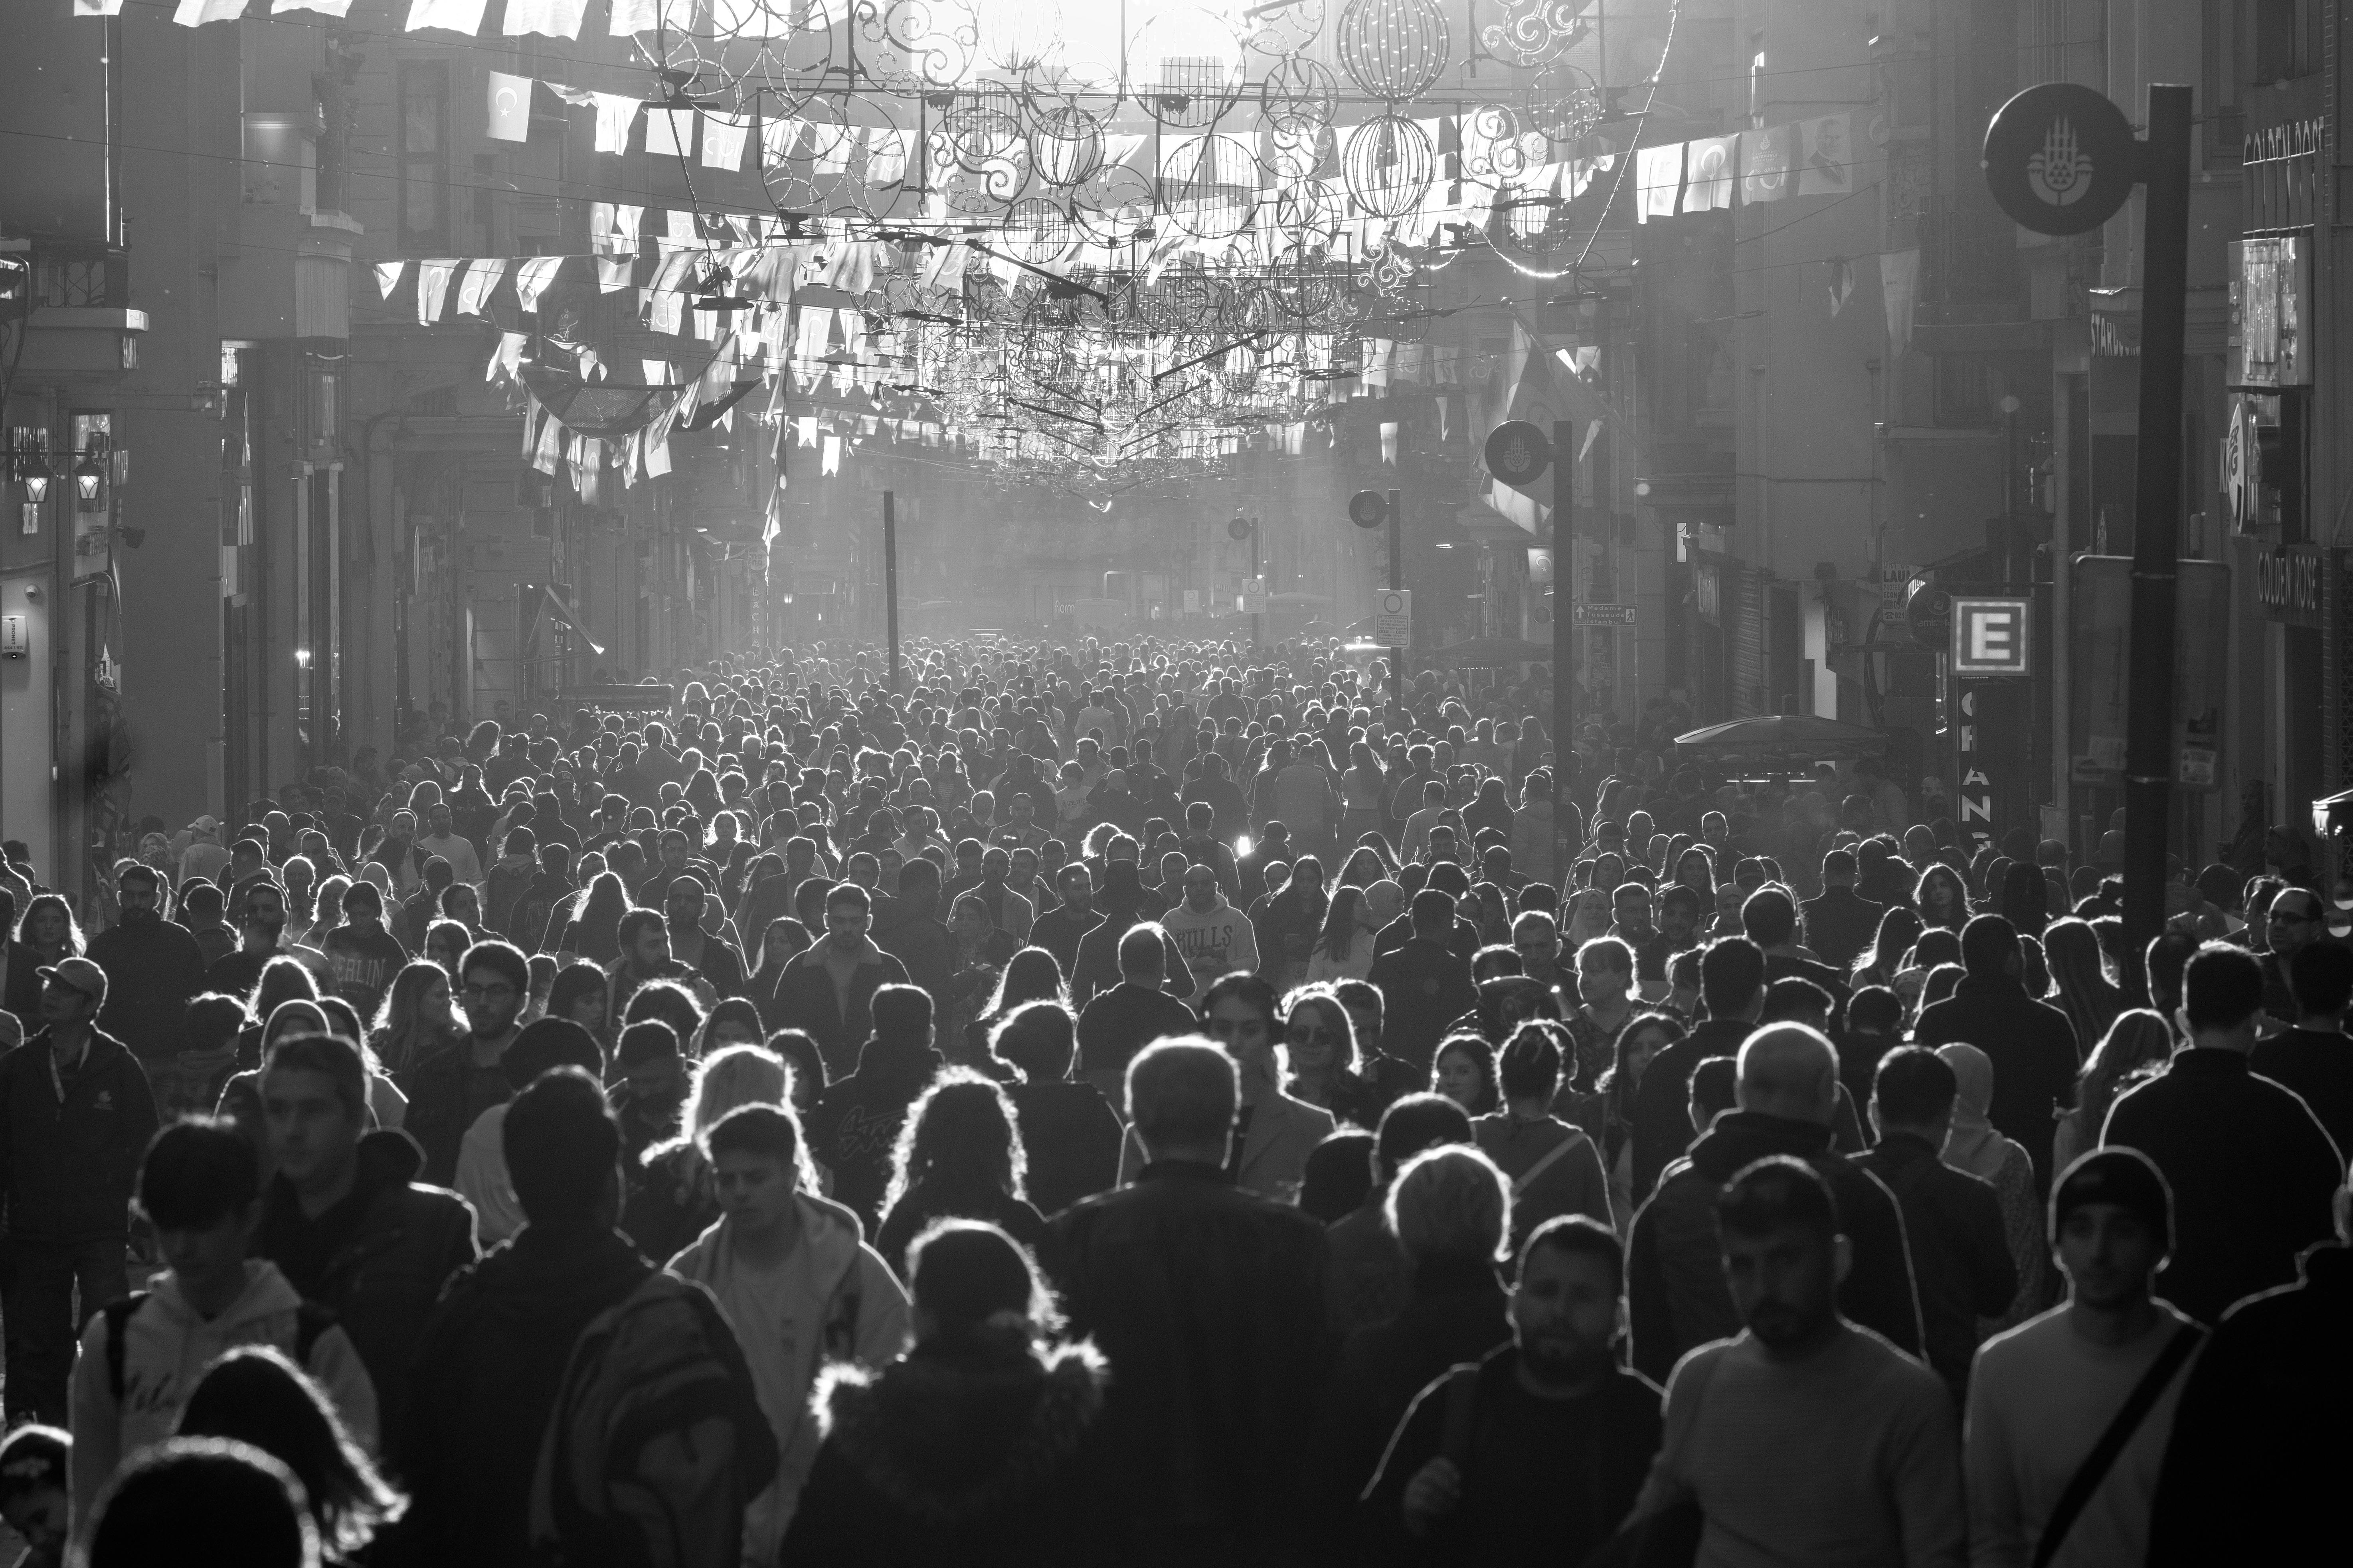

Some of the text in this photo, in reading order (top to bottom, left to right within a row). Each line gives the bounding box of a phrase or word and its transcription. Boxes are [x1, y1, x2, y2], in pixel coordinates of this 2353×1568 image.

[2258, 552, 2316, 610] GOLDEN ROSE
[1971, 612, 2010, 659] E
